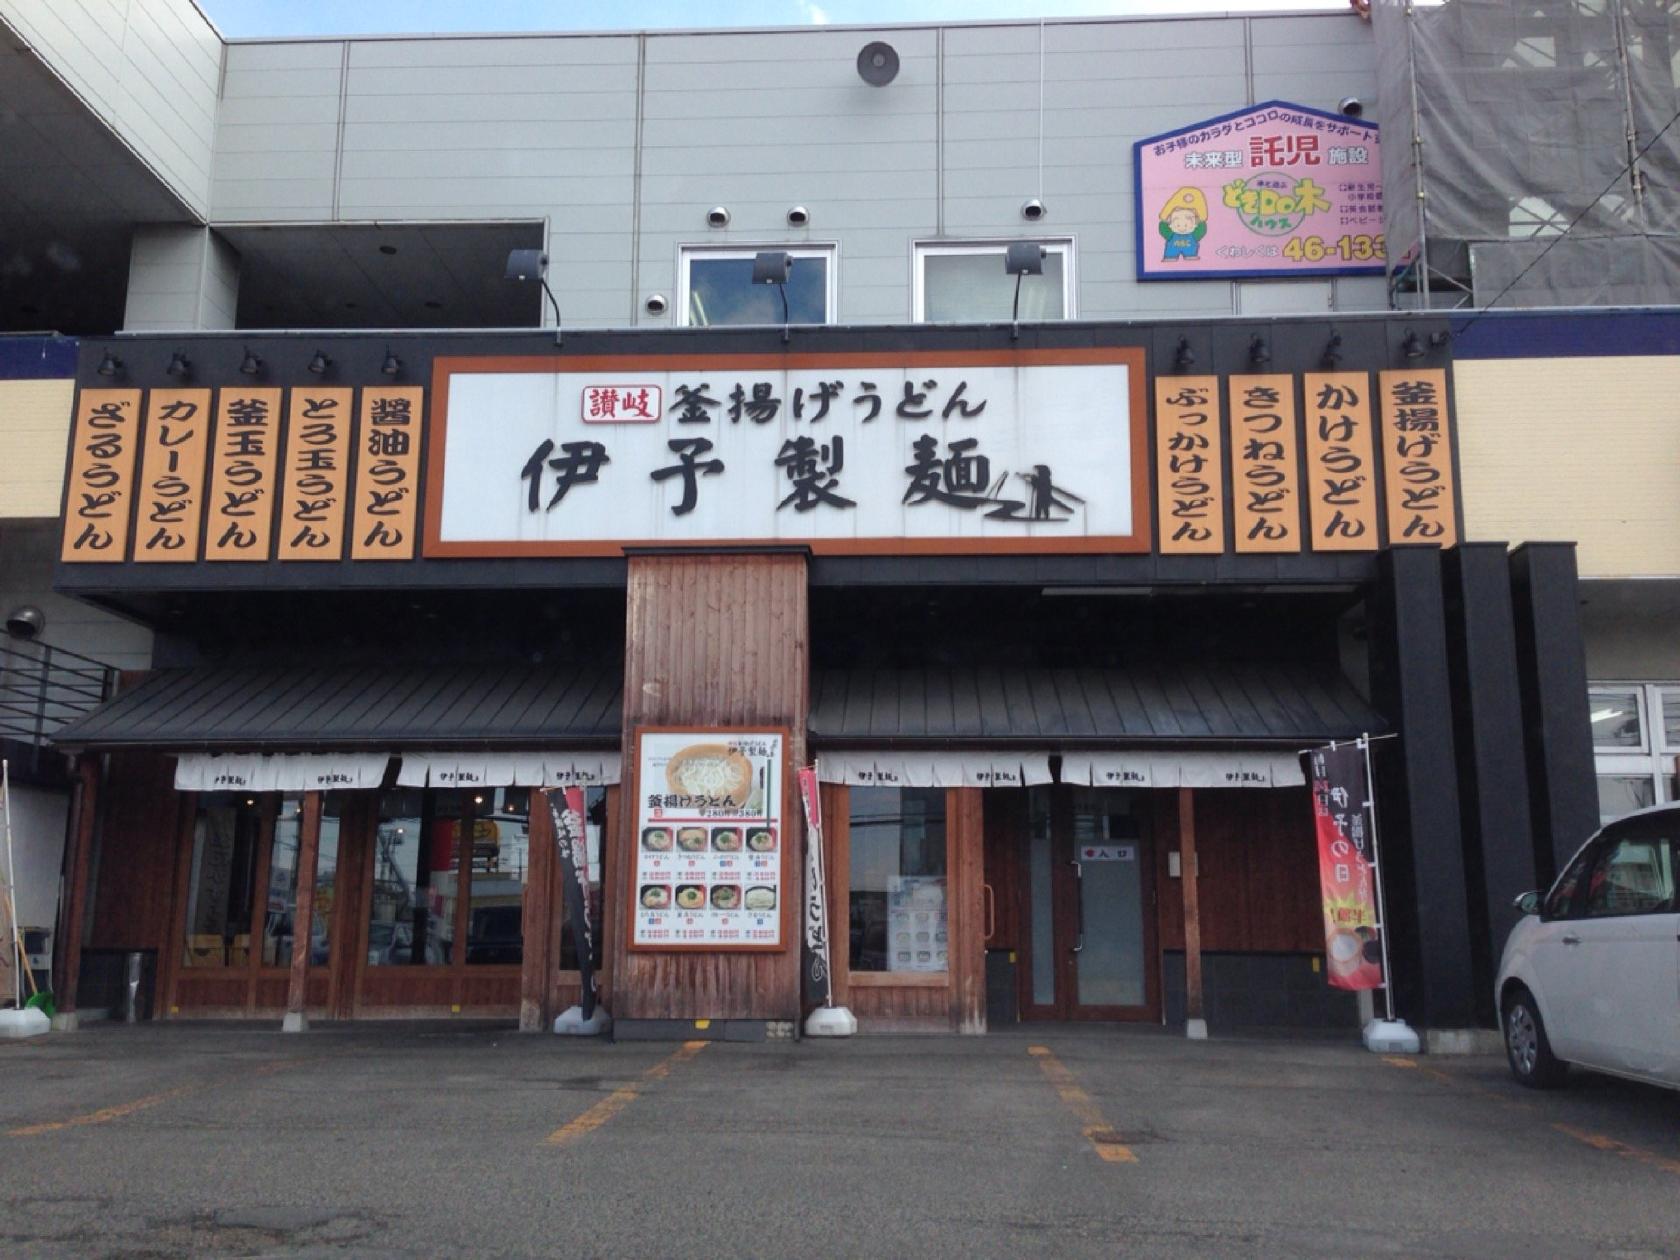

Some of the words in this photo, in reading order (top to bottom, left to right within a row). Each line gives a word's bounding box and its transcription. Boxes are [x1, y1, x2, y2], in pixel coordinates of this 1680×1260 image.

[1184, 150, 1243, 169] 未来型
[1249, 135, 1321, 168] 託児
[1327, 146, 1369, 165] 施設
[73, 400, 131, 550] ざるうどん
[146, 400, 198, 550] カレーうどん
[217, 398, 269, 548] 釜玉うどん
[291, 398, 337, 548] とろ玉うどん
[364, 397, 412, 548] 醤油うどん
[669, 380, 987, 424] 釜揚げうどん
[1166, 387, 1214, 541] ぶっかけうどん
[1243, 387, 1291, 540] きつねうどん
[1316, 383, 1366, 538] かけうどん
[1391, 380, 1445, 538] 釜揚げうどん
